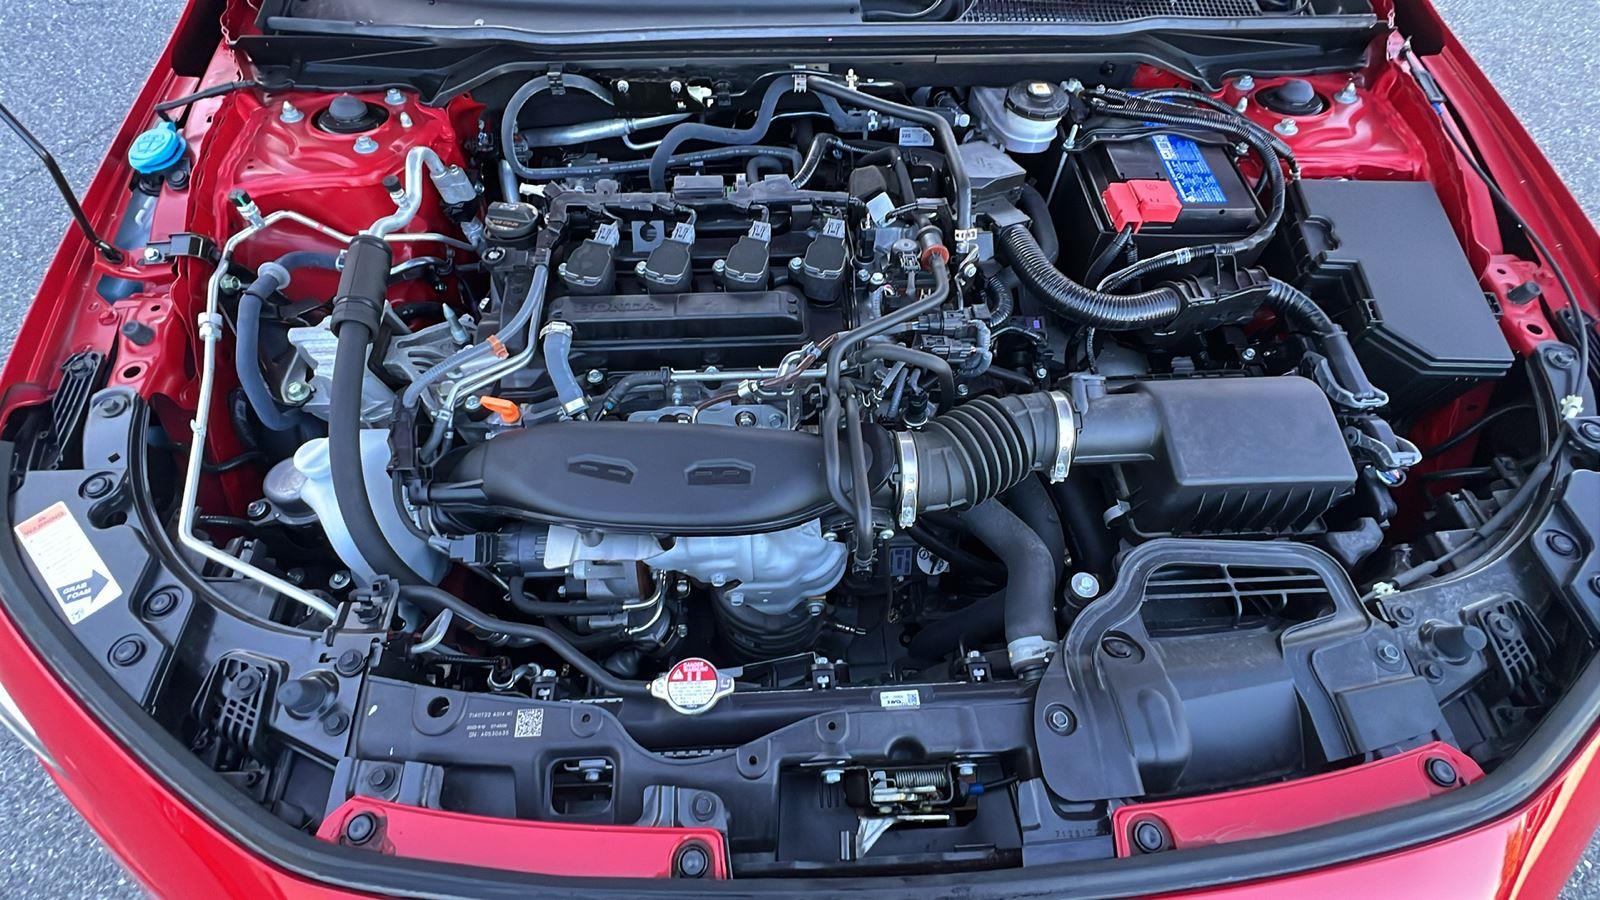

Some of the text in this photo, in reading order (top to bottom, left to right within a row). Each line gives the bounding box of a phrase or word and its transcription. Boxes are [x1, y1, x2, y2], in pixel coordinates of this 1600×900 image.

[575, 302, 662, 313] HONDA
[62, 582, 87, 595] GRAB
[66, 587, 92, 601] FOAM
